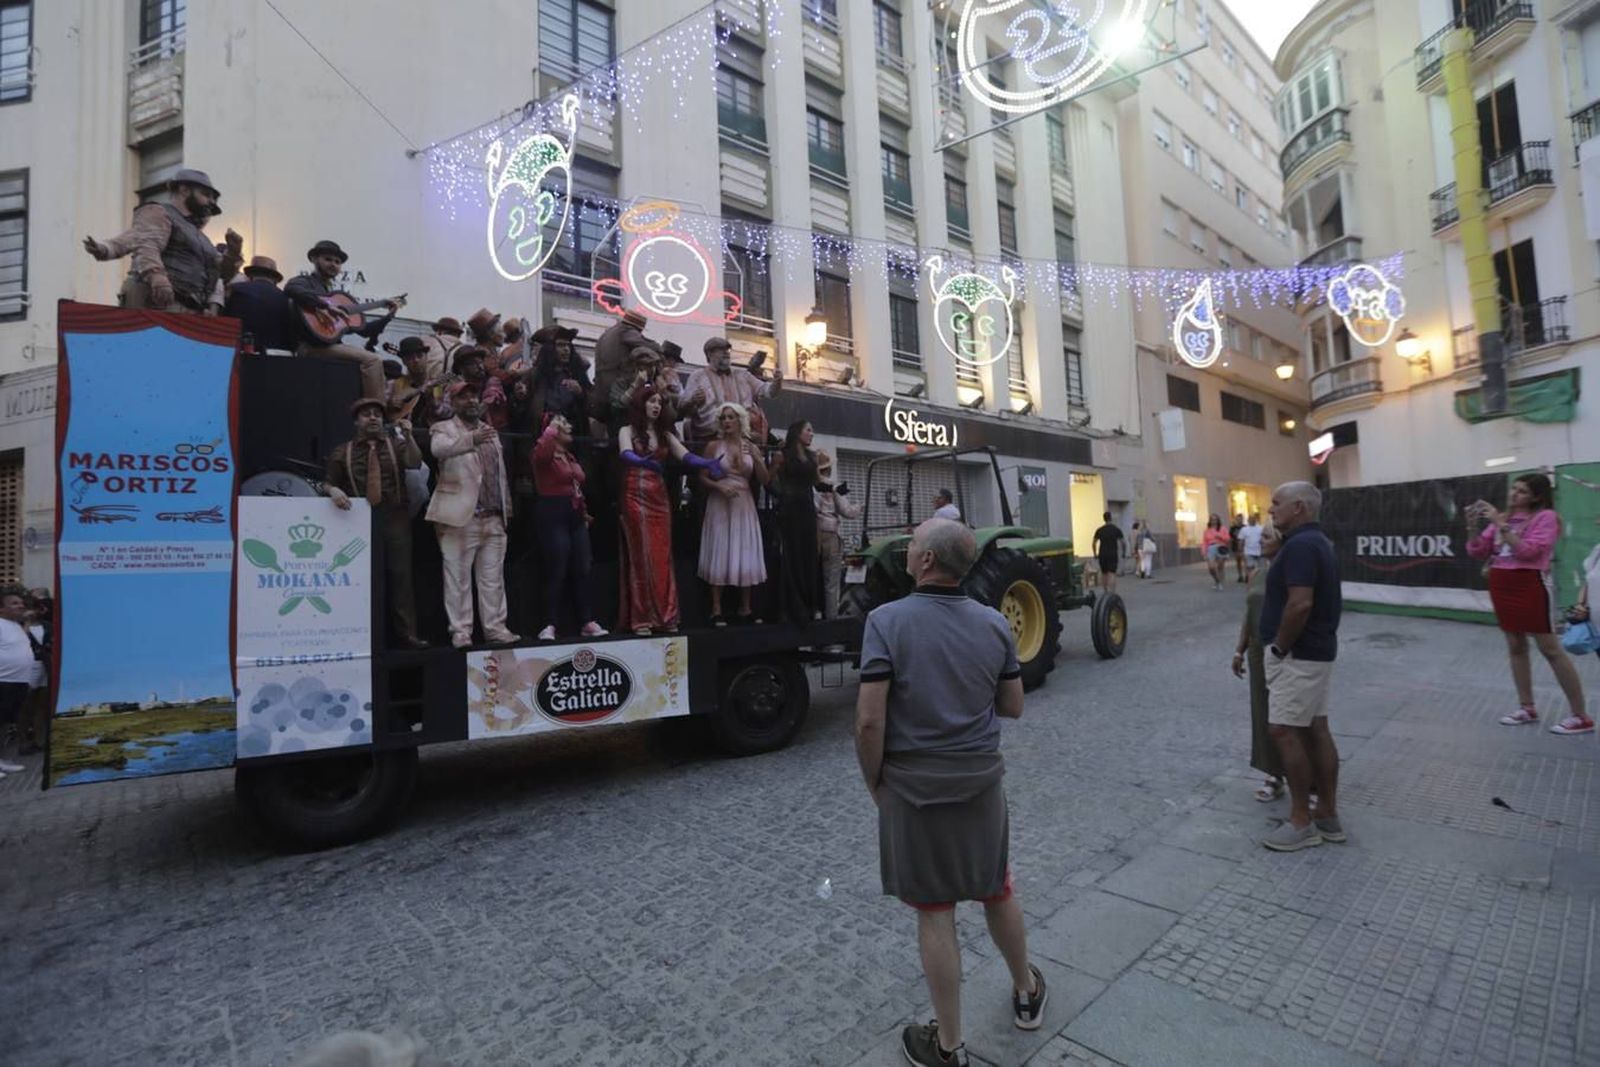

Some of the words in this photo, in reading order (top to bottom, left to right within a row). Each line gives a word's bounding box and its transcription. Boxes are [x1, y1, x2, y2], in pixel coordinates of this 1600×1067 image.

[5, 385, 57, 418] MUJE
[69, 452, 229, 473] MARISCOS
[104, 476, 197, 494] ORTIZ
[1356, 535, 1454, 557] PRIMOR
[257, 572, 351, 589] MOKANA
[546, 669, 623, 692] Estrella
[550, 687, 619, 712] Galicia
